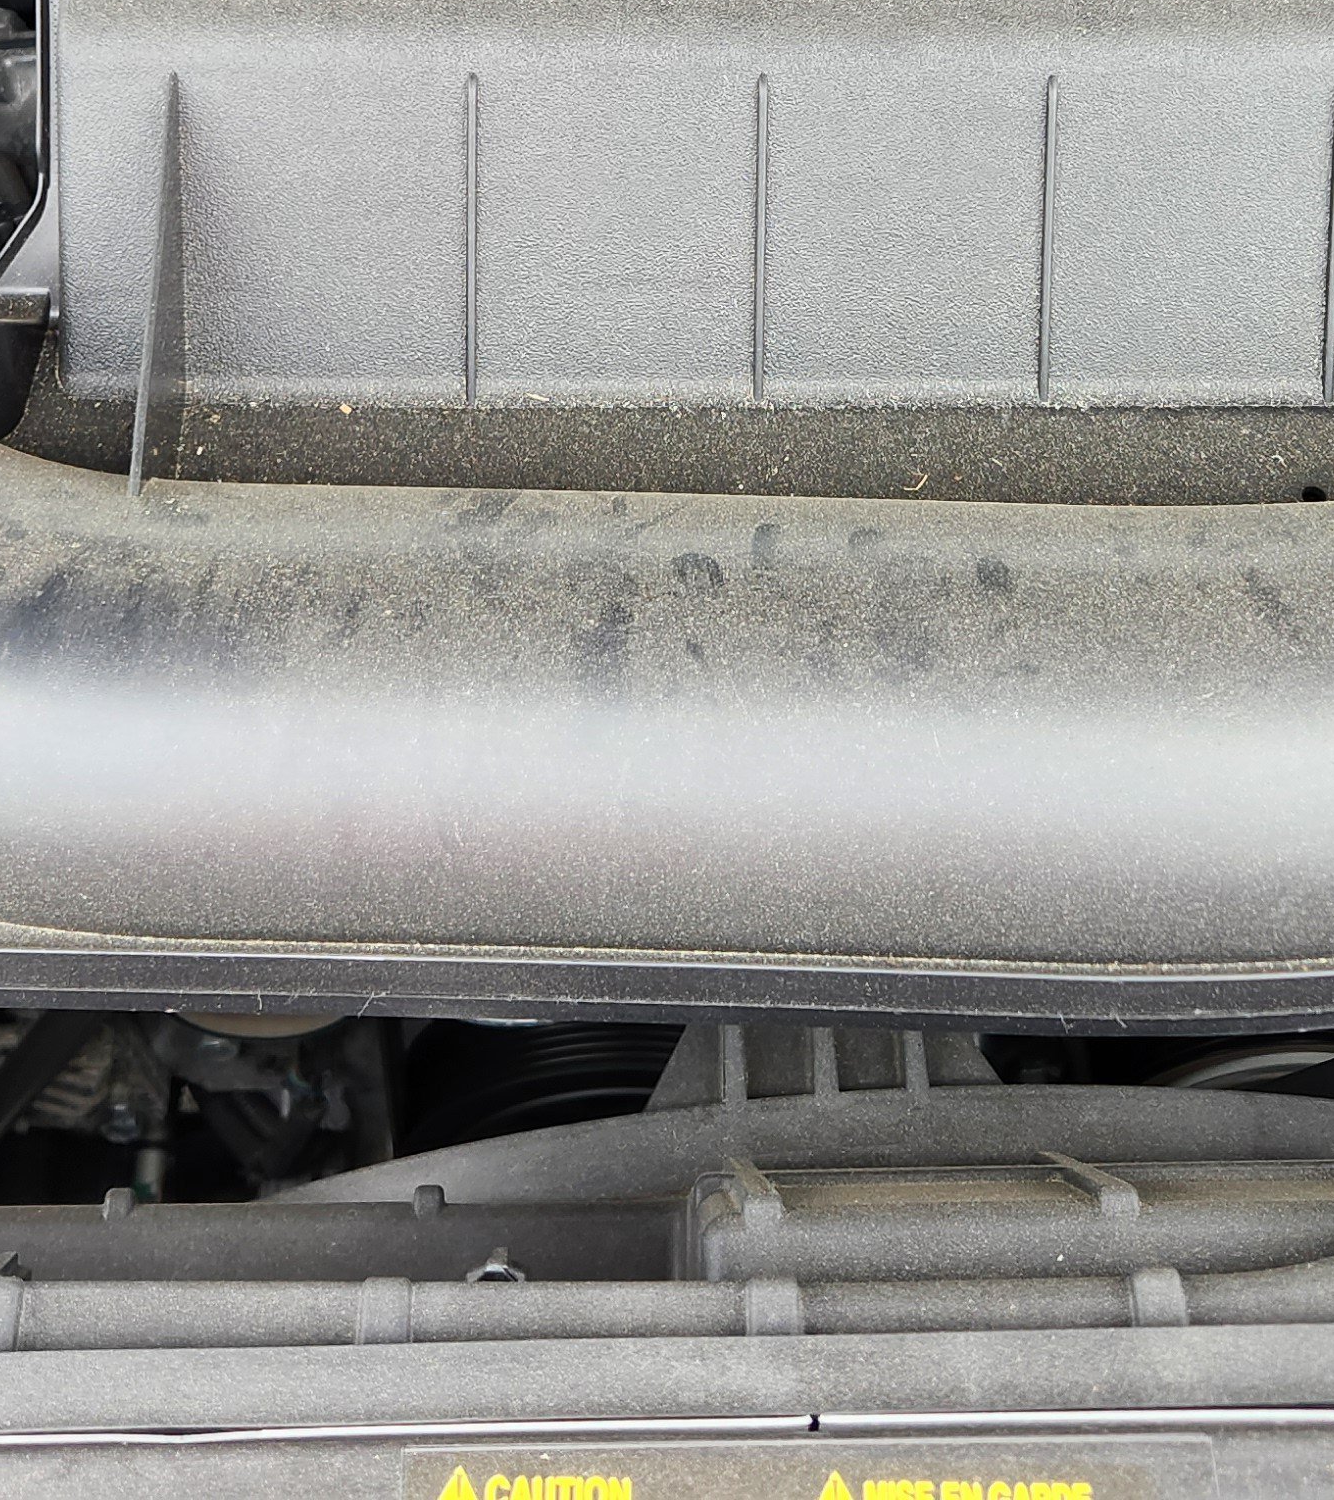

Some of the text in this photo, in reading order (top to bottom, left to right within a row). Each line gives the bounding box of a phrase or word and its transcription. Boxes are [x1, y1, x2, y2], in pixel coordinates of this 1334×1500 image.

[483, 1473, 633, 1500] CAUTION
[862, 1479, 1095, 1500] MISE EN GARDE
